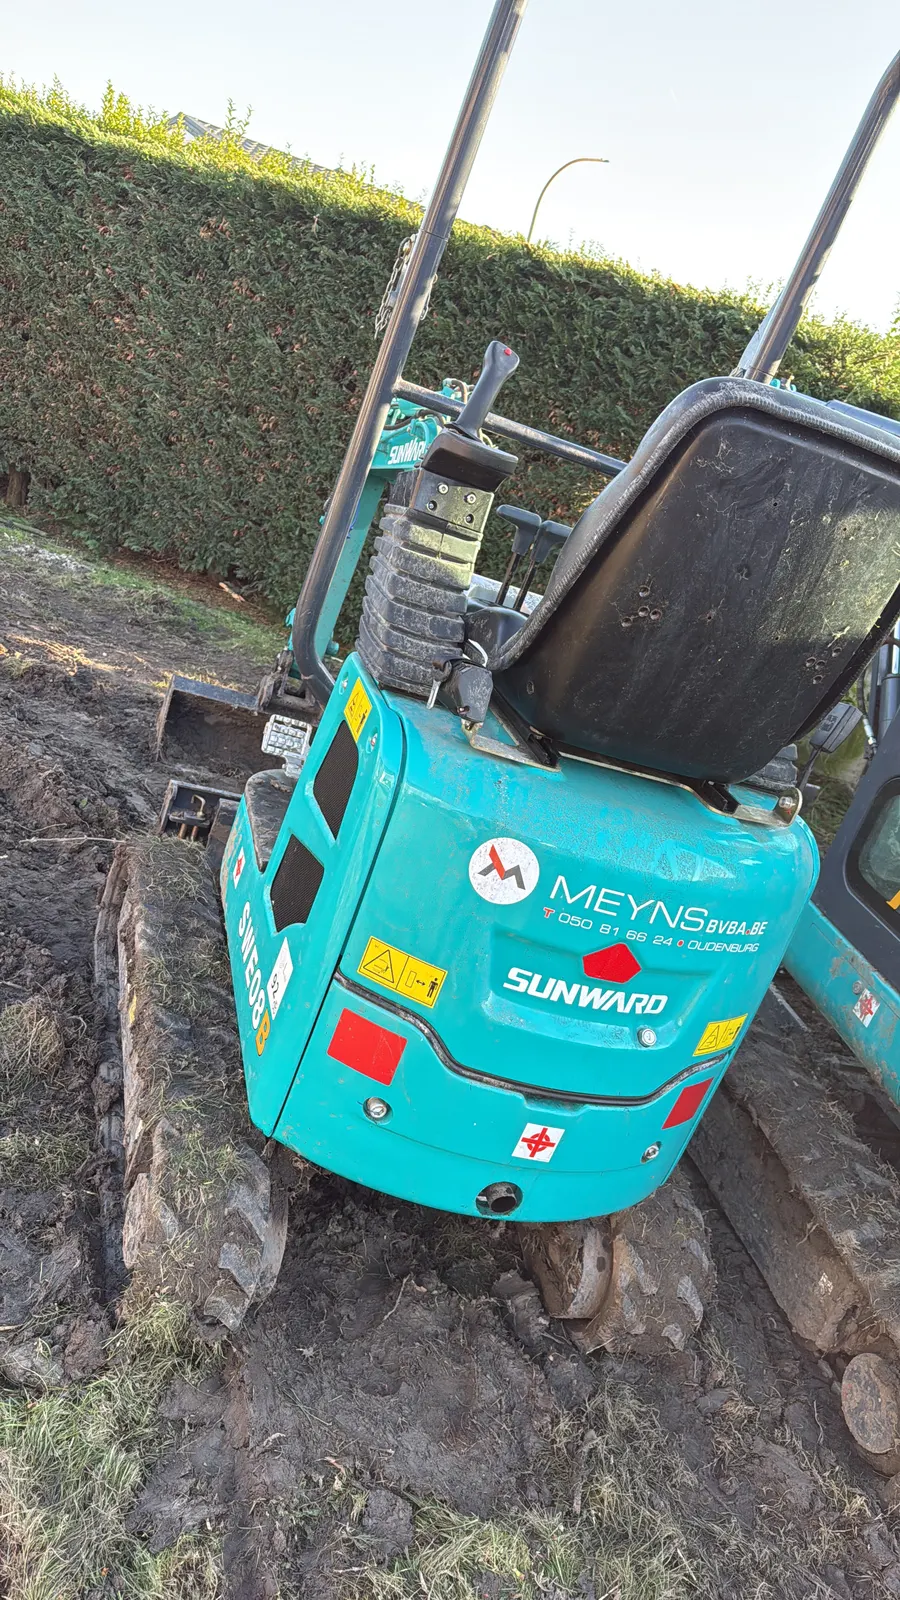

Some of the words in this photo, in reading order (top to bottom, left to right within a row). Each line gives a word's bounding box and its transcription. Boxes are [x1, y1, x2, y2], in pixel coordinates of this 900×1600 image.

[387, 437, 427, 465] SUNWAR
[549, 875, 709, 932] MEYNS
[543, 907, 554, 918] T
[558, 912, 593, 930] 050
[599, 924, 620, 937] 81
[625, 929, 648, 943] 66
[652, 935, 673, 947] 24
[687, 939, 759, 953] OUDENBURG
[238, 901, 271, 1056] SWE08B
[503, 967, 668, 1015] SUNWARD
